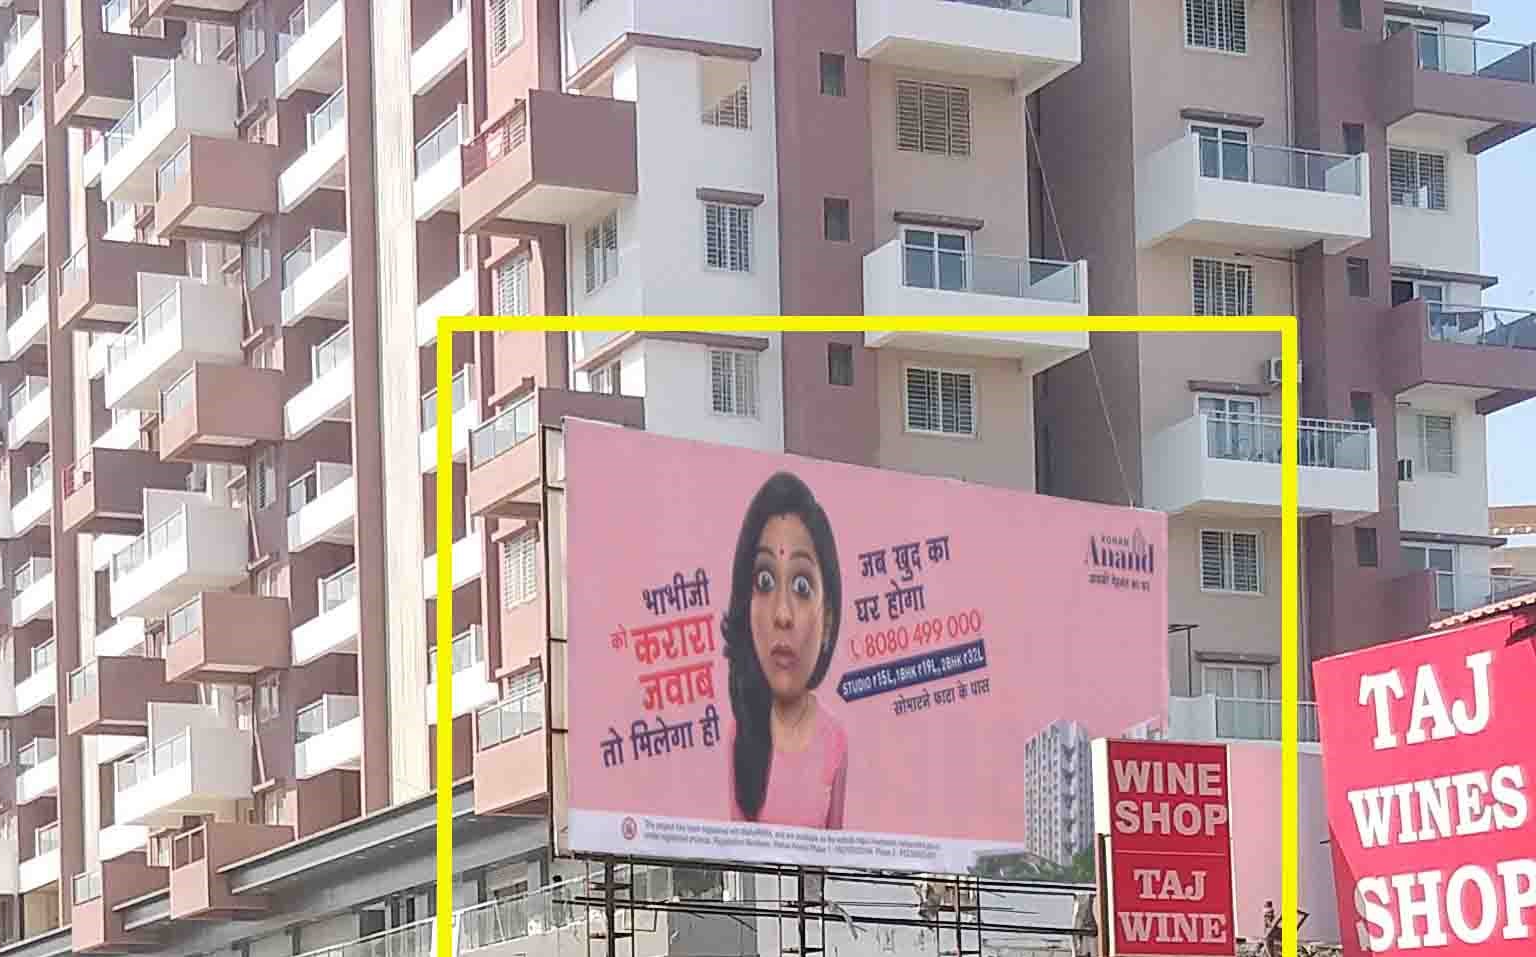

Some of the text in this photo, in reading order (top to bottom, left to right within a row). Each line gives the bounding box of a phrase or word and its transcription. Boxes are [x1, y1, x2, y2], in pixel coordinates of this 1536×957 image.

[858, 536, 950, 581] जब खुद का
[1083, 536, 1154, 573] Anand
[642, 567, 711, 616] भाभीजी
[854, 579, 925, 623] घर होगा
[610, 614, 716, 664] को करारा
[865, 609, 982, 659] 8080 499 000
[638, 661, 716, 711] जवाब
[842, 676, 872, 696] STUDIO
[1357, 651, 1495, 751] TAJ
[600, 704, 720, 767] तो मिलेगा ही
[1113, 759, 1223, 797] WINE
[1115, 800, 1228, 836] SHOP
[1348, 763, 1527, 850] WINES
[1133, 869, 1207, 901] TAJ
[1117, 911, 1227, 944] WINE
